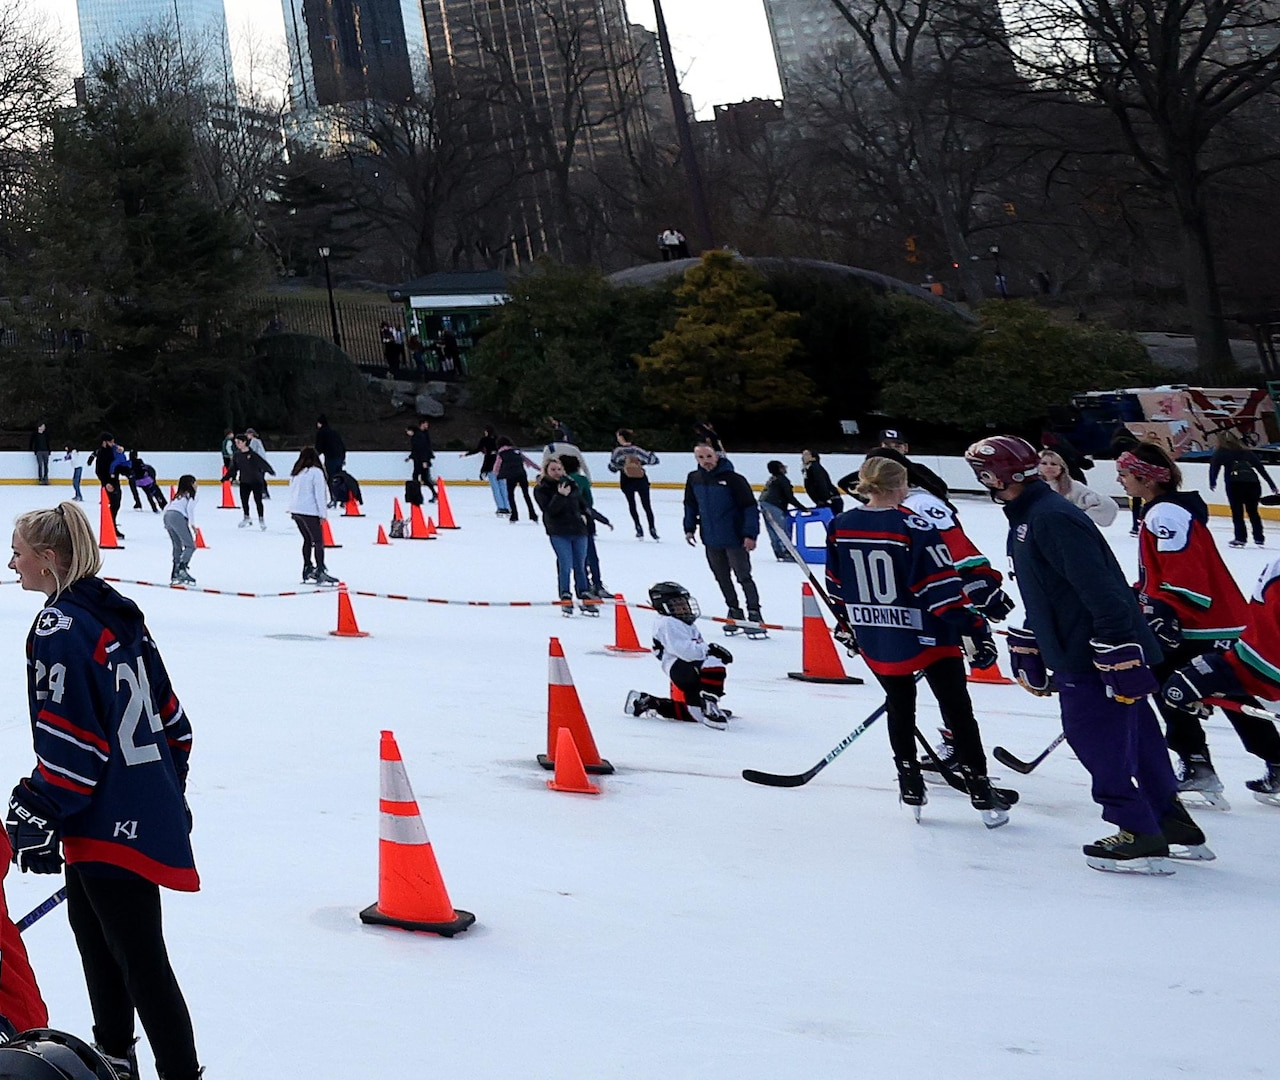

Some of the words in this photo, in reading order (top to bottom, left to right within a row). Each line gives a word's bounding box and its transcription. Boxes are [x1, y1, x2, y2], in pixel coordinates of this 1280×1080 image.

[849, 549, 898, 604] 10
[925, 544, 953, 568] 10
[35, 659, 67, 704] 24
